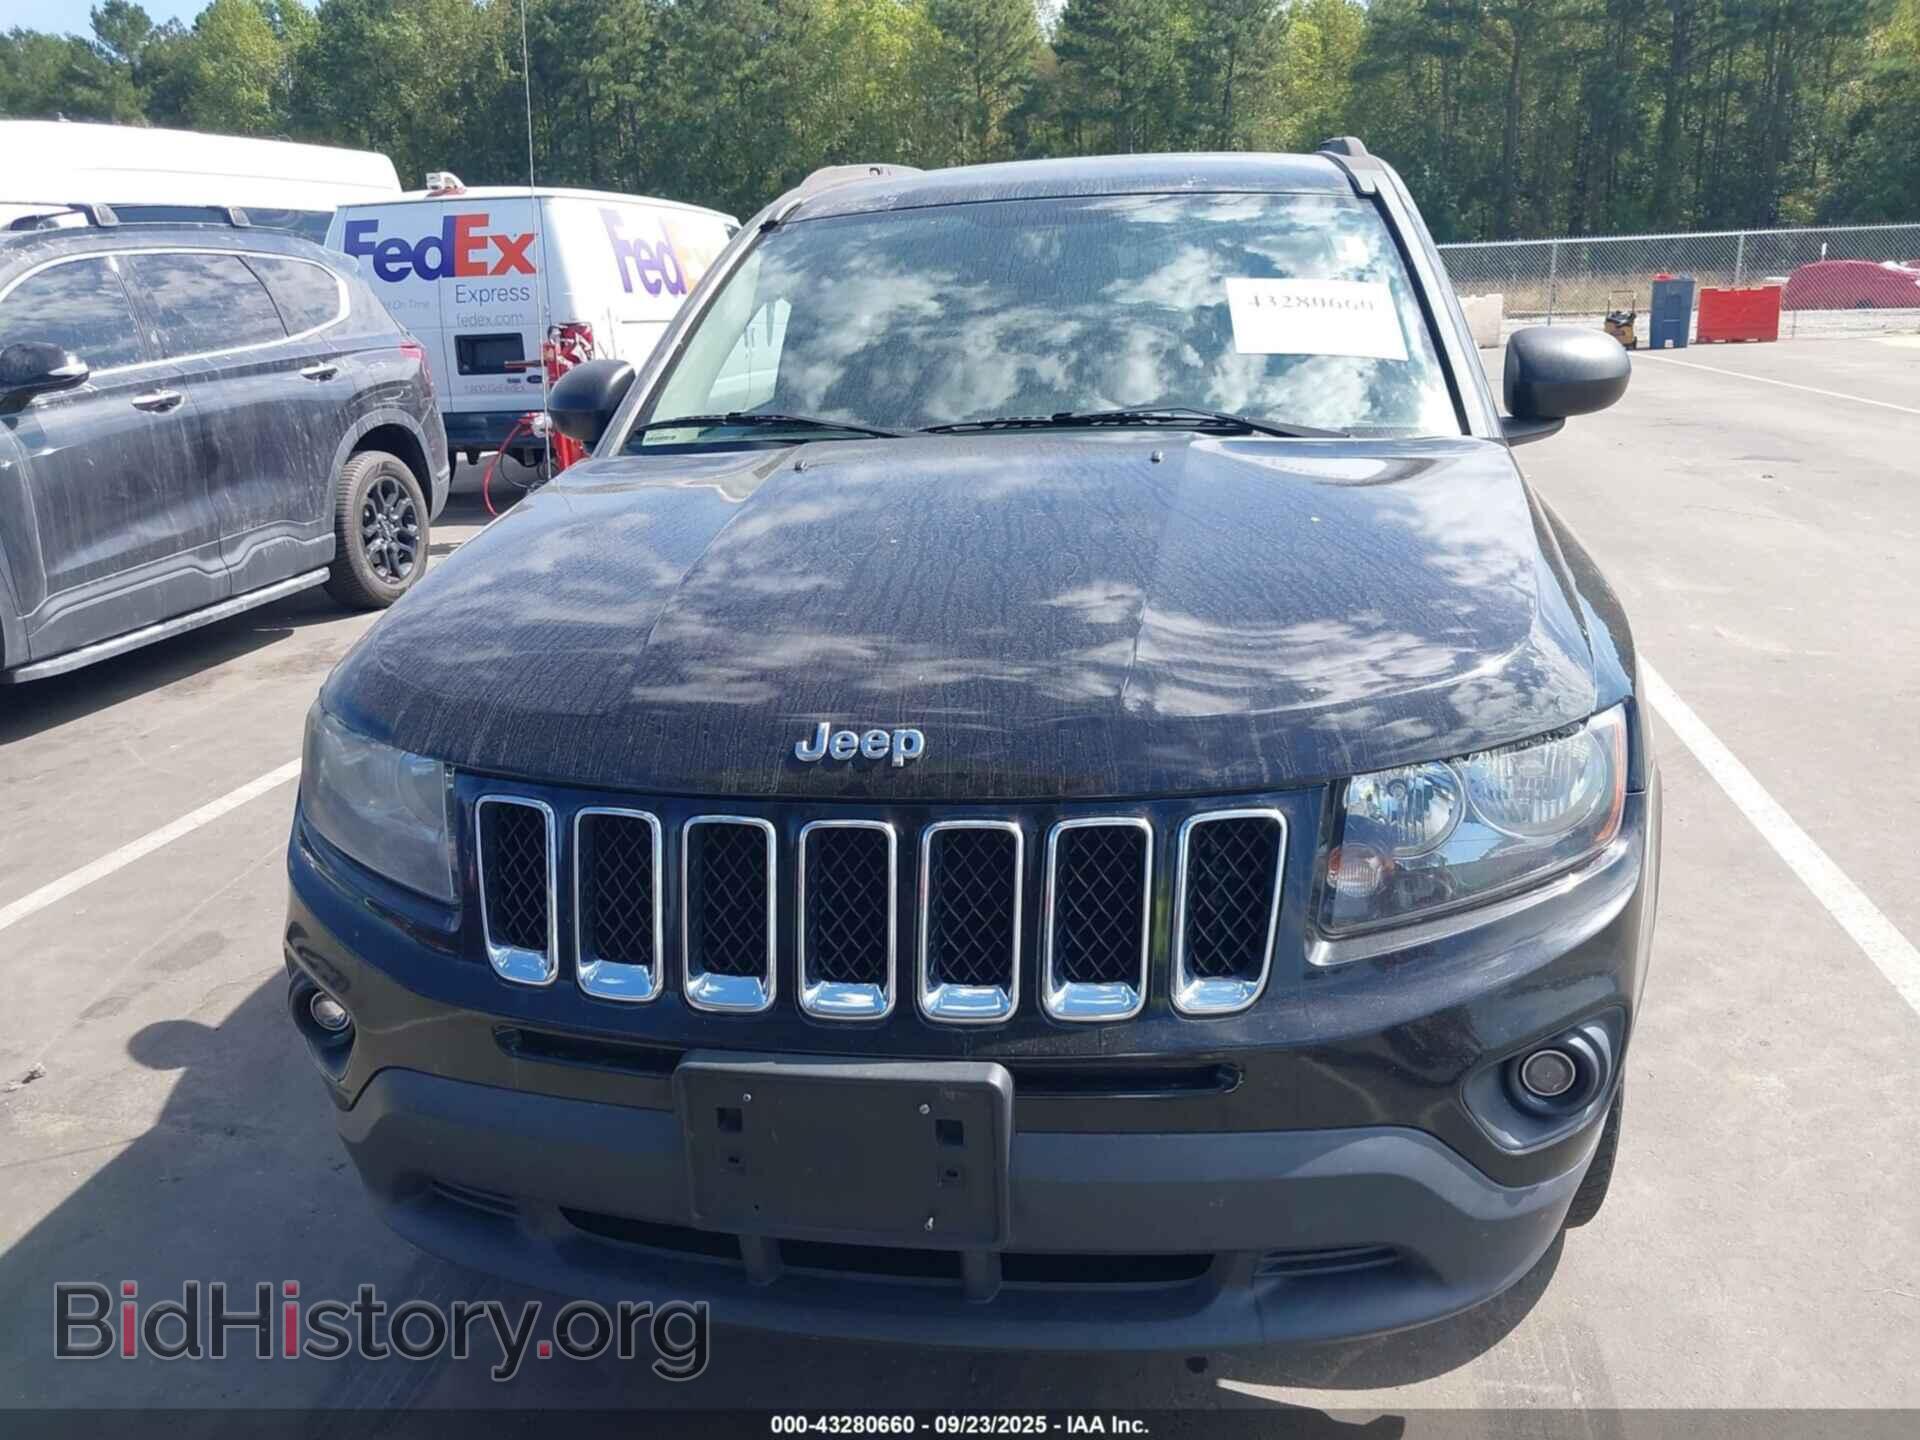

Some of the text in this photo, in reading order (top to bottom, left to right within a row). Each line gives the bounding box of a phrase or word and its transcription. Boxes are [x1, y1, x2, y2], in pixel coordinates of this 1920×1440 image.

[344, 213, 537, 283] FedEx
[455, 284, 530, 306] Express
[456, 311, 524, 328] fedex.com
[795, 722, 925, 767] Jeep
